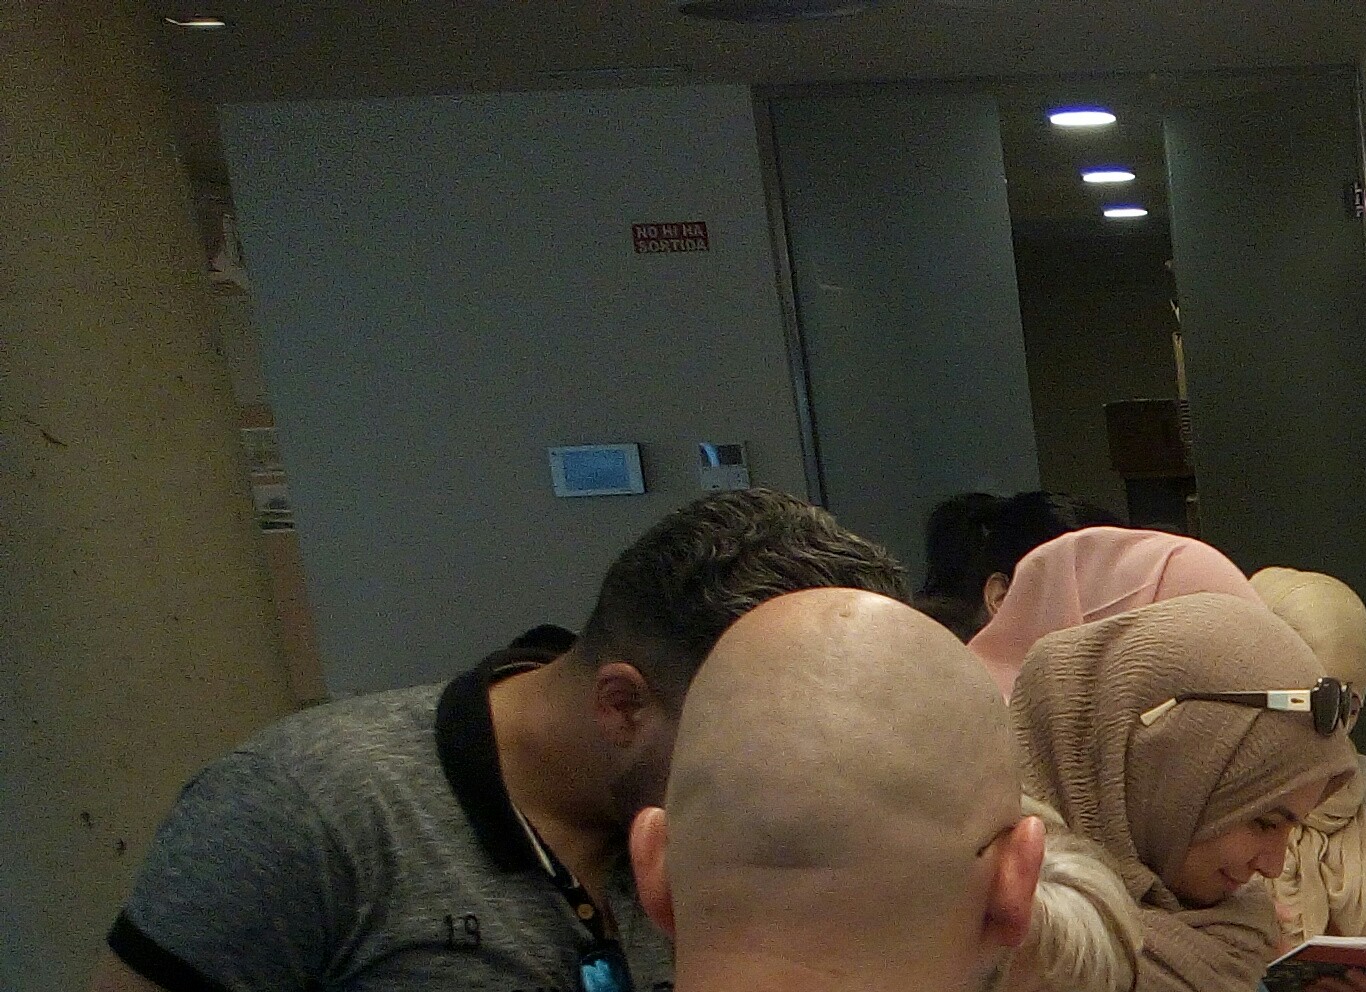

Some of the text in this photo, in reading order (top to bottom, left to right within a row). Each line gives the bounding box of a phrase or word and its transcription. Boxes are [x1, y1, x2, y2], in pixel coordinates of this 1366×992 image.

[636, 223, 705, 239] NO HI HA
[637, 239, 707, 252] SORTIDA
